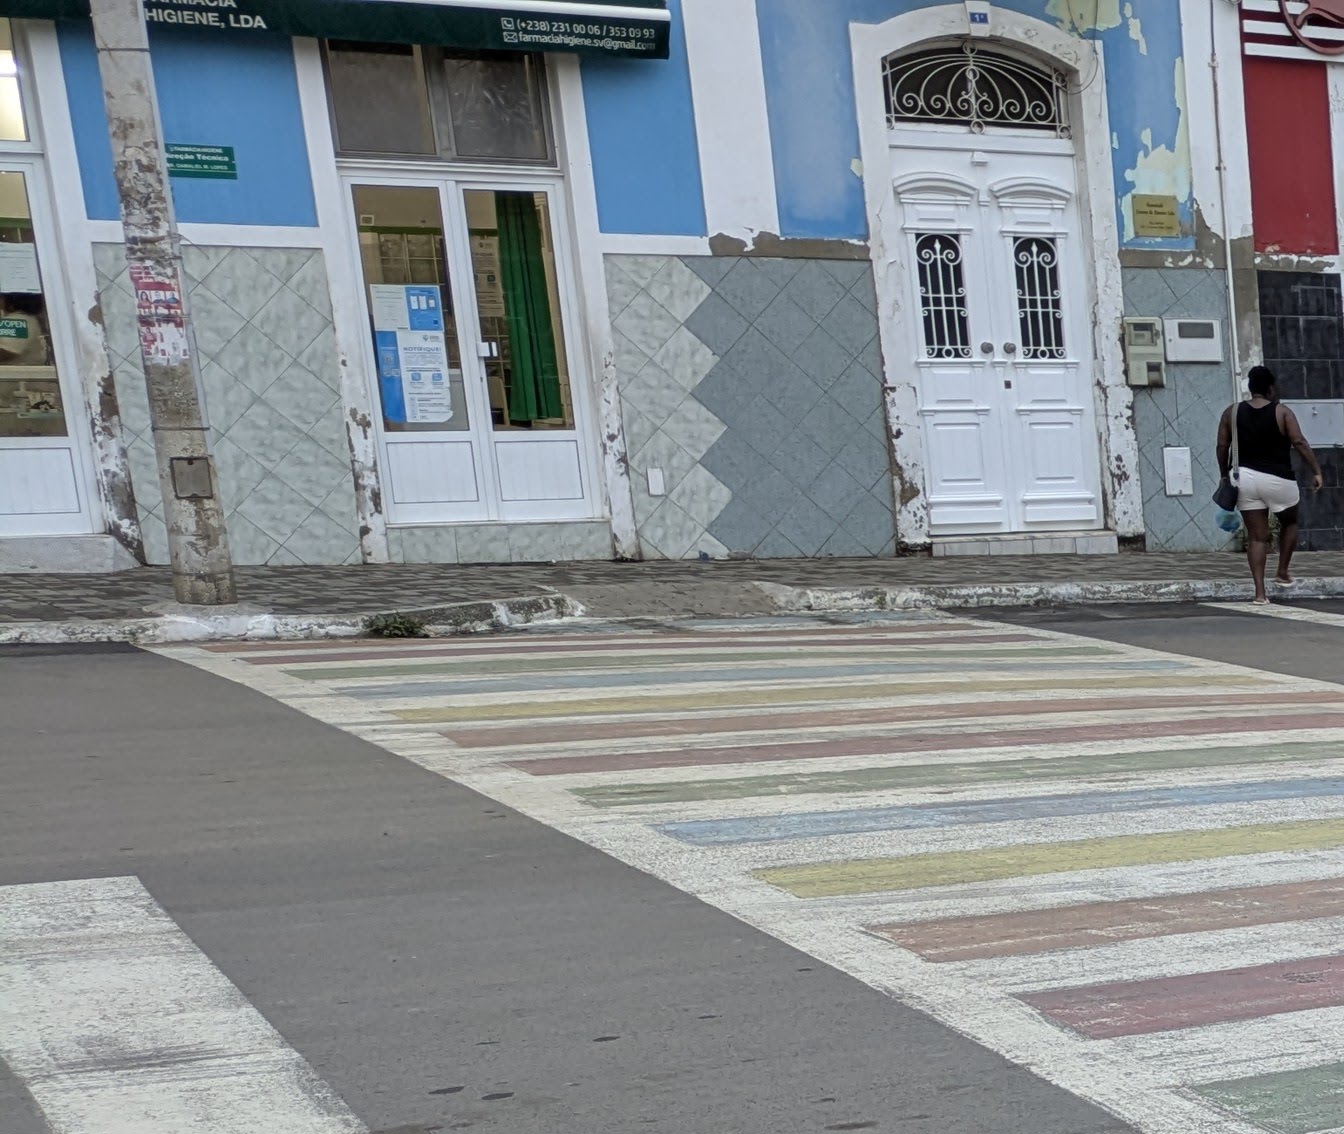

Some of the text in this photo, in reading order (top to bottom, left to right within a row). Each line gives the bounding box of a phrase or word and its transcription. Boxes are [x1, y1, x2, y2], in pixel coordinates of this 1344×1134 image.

[144, 8, 268, 29] HIGIENE, LDA
[517, 19, 550, 32] (+238)
[552, 22, 570, 33] 231
[573, 23, 586, 34] 00
[588, 24, 601, 35] 06
[609, 26, 627, 37] 353
[628, 27, 642, 38] 09
[643, 28, 655, 39] 93
[518, 32, 656, 50] farmaciahigiene.sv@gmail.com
[196, 153, 229, 161] Técnica
